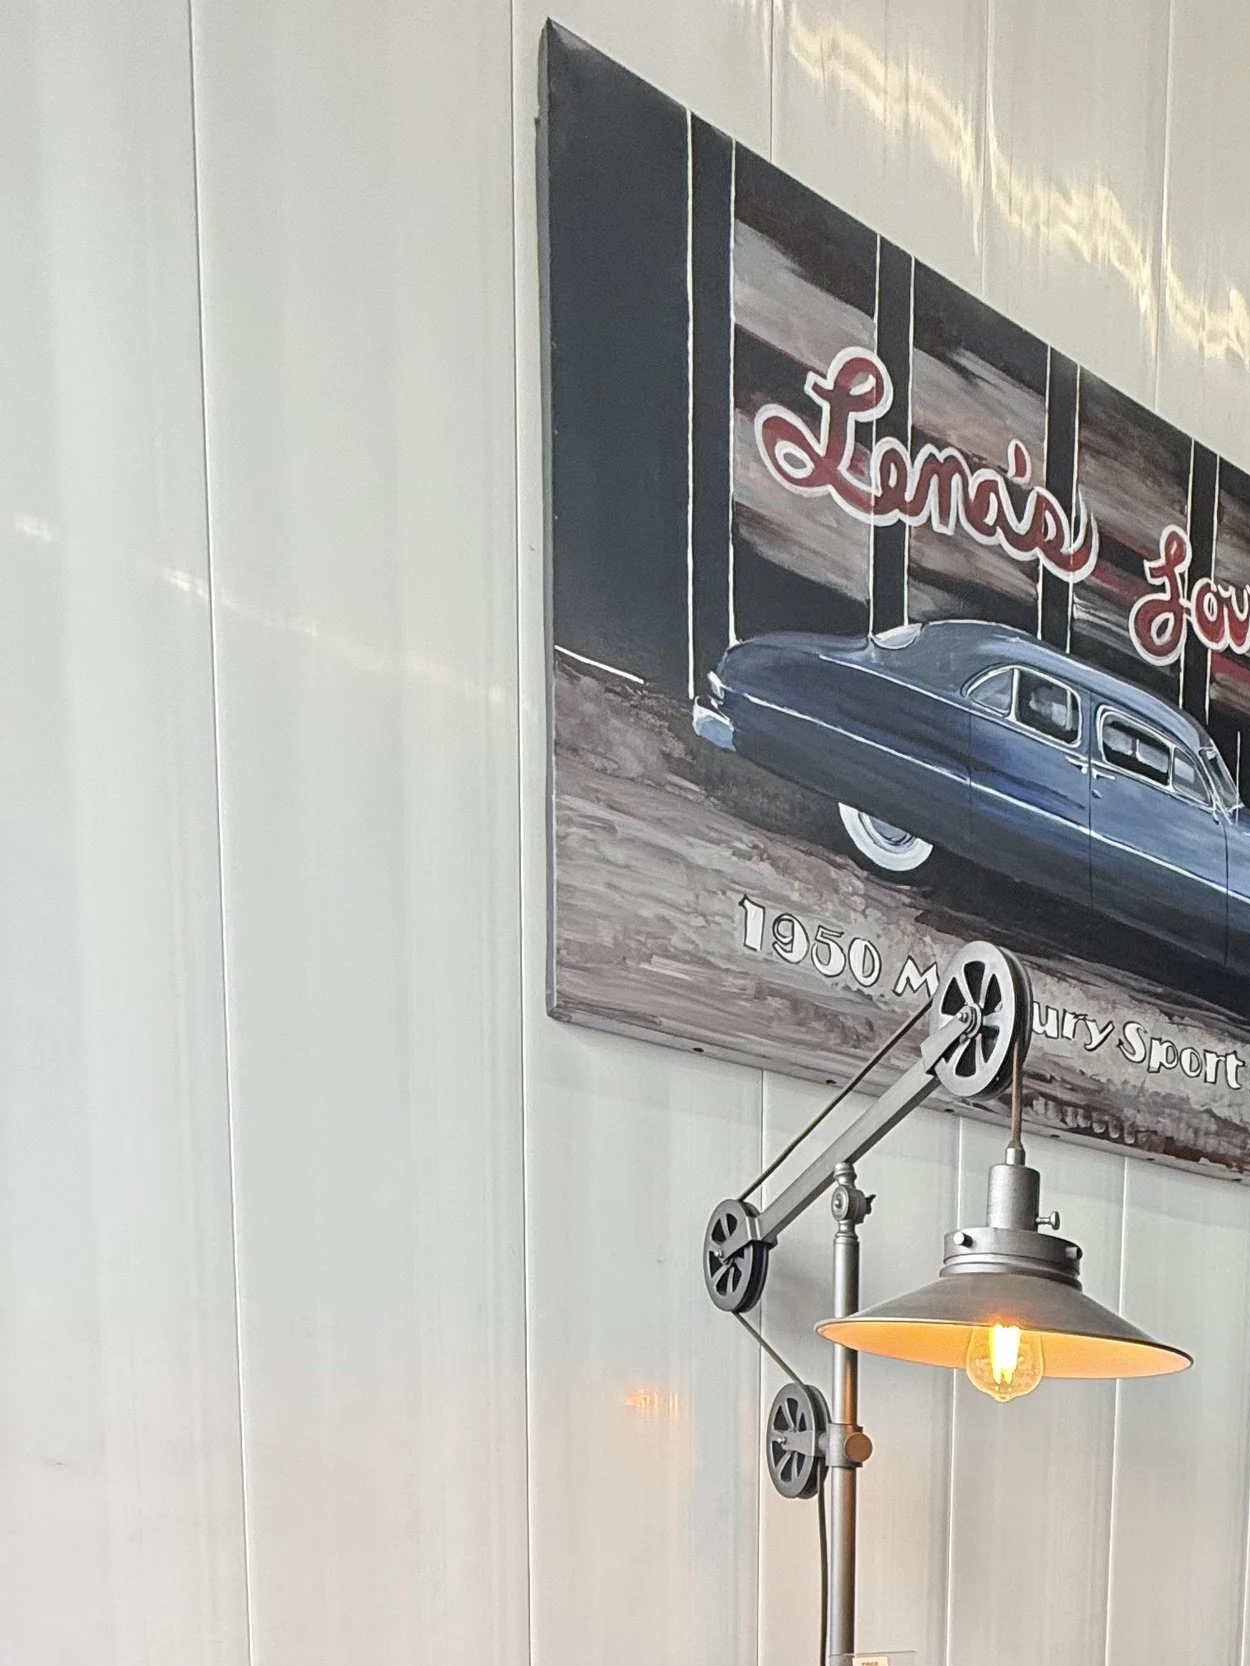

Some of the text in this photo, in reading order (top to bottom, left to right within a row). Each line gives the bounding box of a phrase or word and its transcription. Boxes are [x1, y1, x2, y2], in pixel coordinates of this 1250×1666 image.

[754, 346, 1099, 583] Lena's
[738, 893, 883, 988] 1950
[892, 954, 1113, 1053] Mury
[1117, 1020, 1245, 1091] Sport
